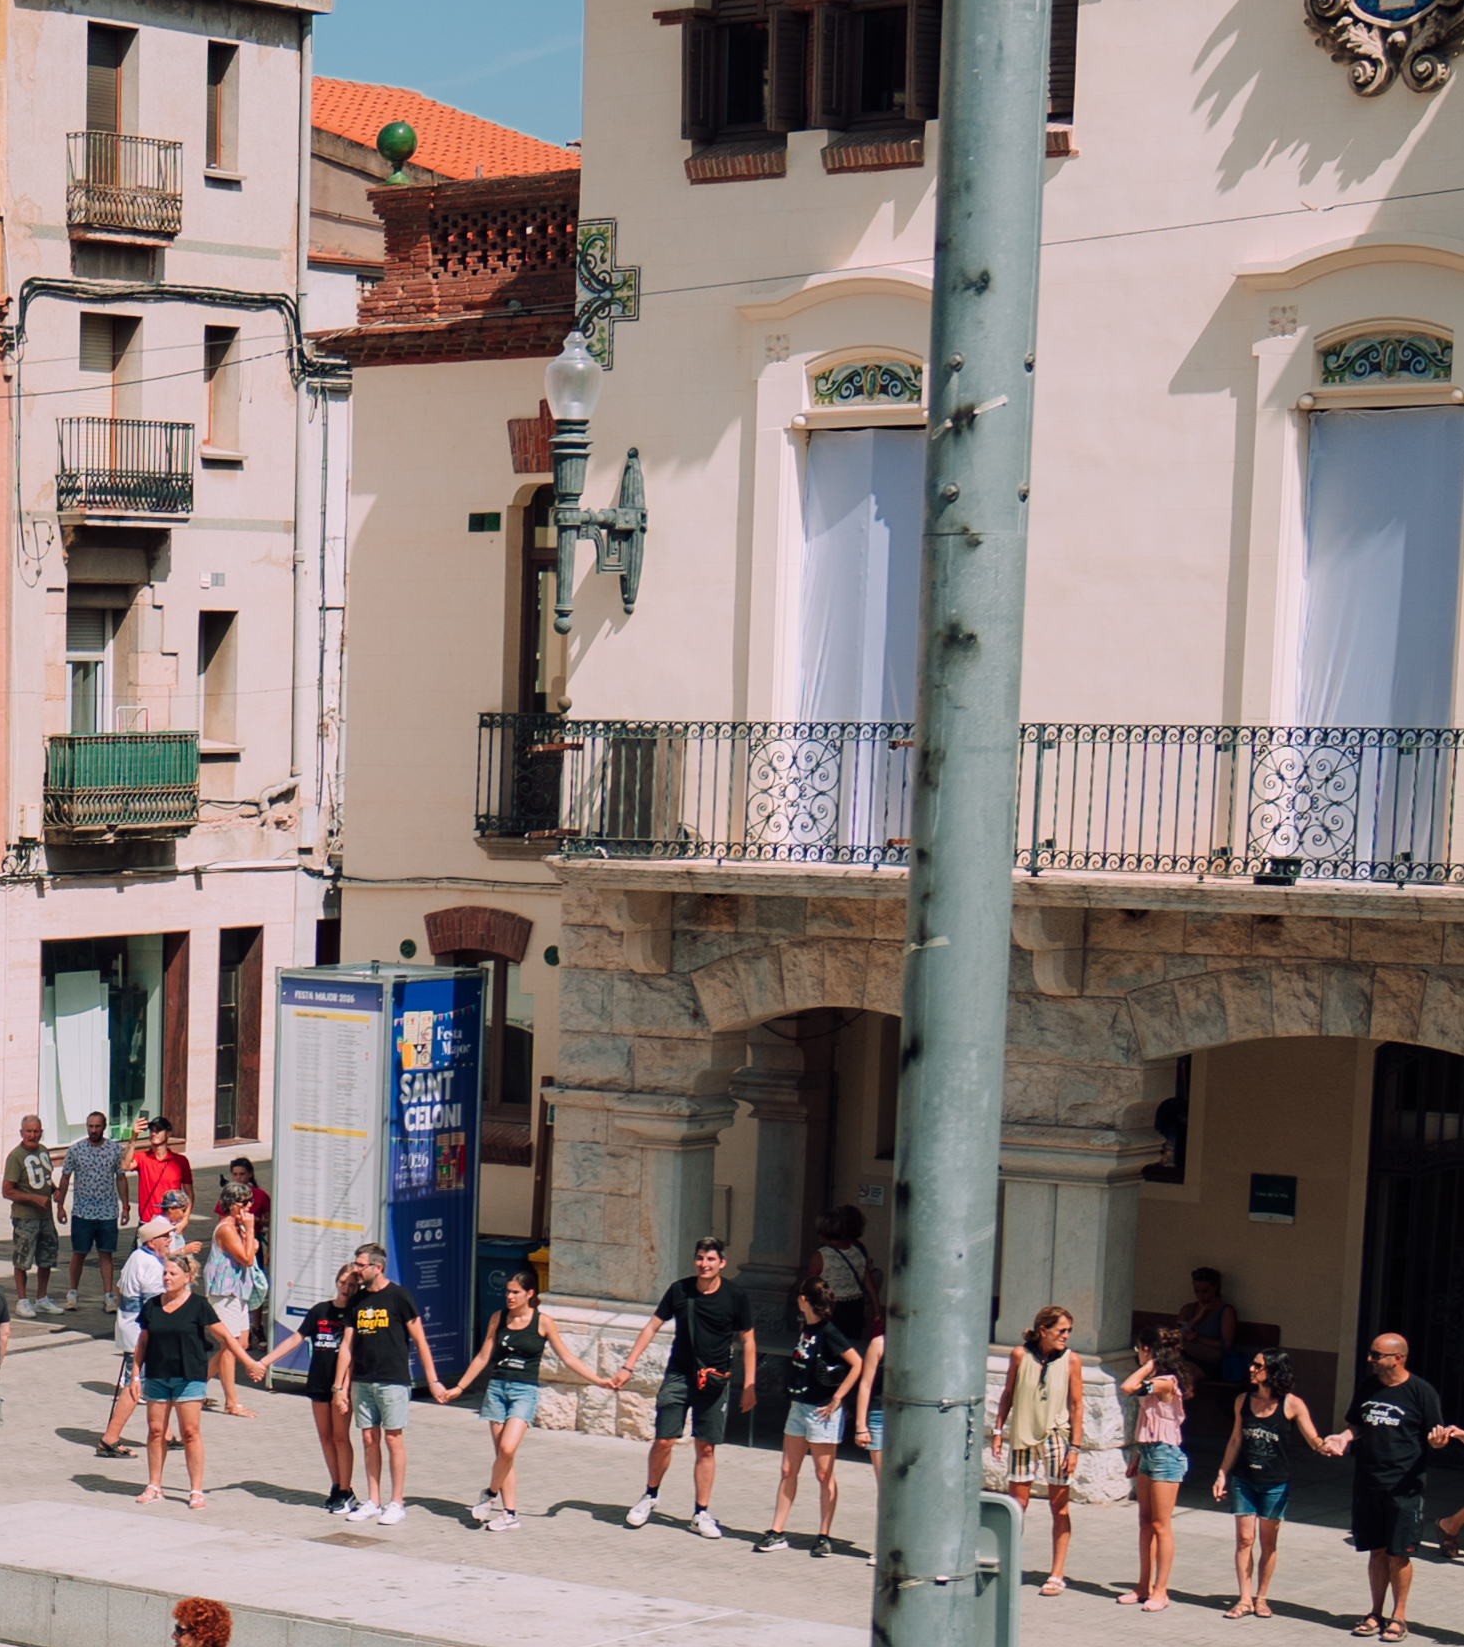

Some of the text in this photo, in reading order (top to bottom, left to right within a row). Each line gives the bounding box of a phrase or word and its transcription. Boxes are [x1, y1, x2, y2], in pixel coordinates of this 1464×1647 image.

[294, 990, 314, 1001] FESTA
[314, 991, 338, 1002] MAJOR
[436, 1026, 463, 1041] Festa
[441, 1041, 472, 1058] Major
[399, 1070, 455, 1104] SANT
[404, 1103, 462, 1132] CELONI
[399, 1151, 430, 1169] 2026
